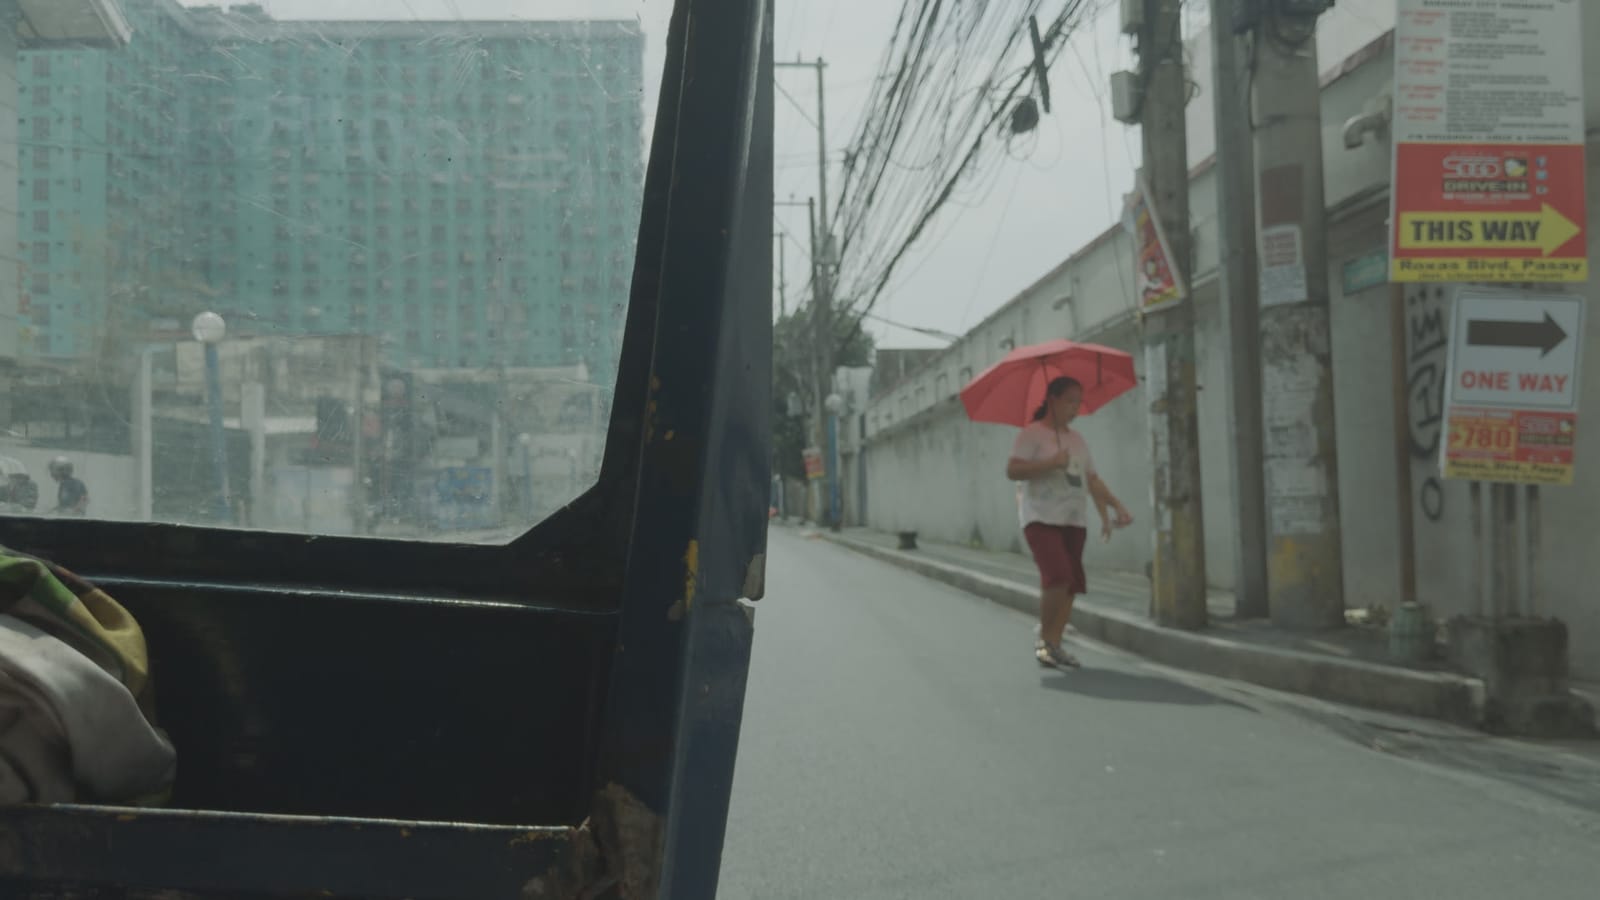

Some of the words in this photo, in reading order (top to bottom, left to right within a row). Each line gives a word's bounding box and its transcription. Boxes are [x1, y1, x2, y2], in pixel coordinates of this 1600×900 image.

[1444, 180, 1528, 193] DRIVE-IN
[1411, 220, 1474, 241] THIS
[1481, 220, 1541, 241] WAY
[1400, 258, 1460, 271] Roxas
[1522, 258, 1582, 274] Pasay
[1461, 370, 1511, 391] ONE
[1518, 372, 1569, 393] WAY
